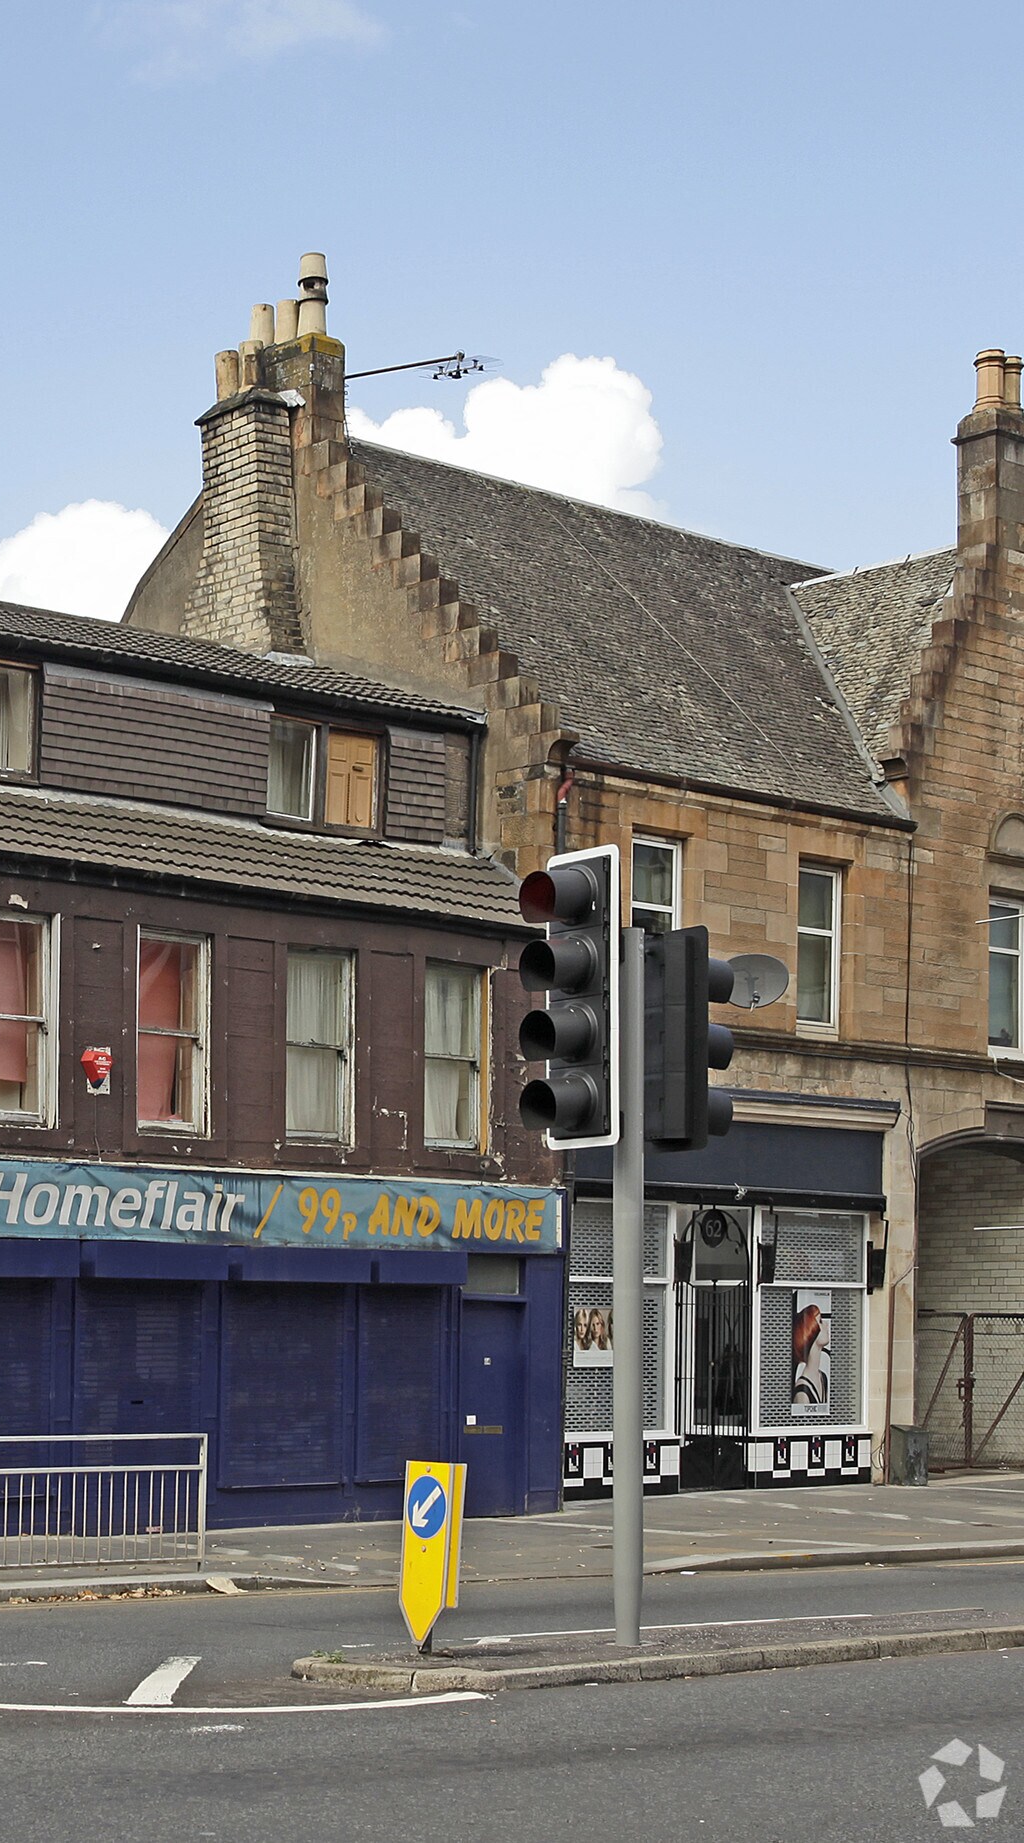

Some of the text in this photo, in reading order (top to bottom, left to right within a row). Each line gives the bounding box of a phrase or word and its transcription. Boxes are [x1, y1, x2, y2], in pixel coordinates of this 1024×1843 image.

[297, 1186, 358, 1241] 99p
[367, 1193, 442, 1238] AND
[450, 1198, 547, 1244] MORE
[705, 1219, 722, 1238] 62
